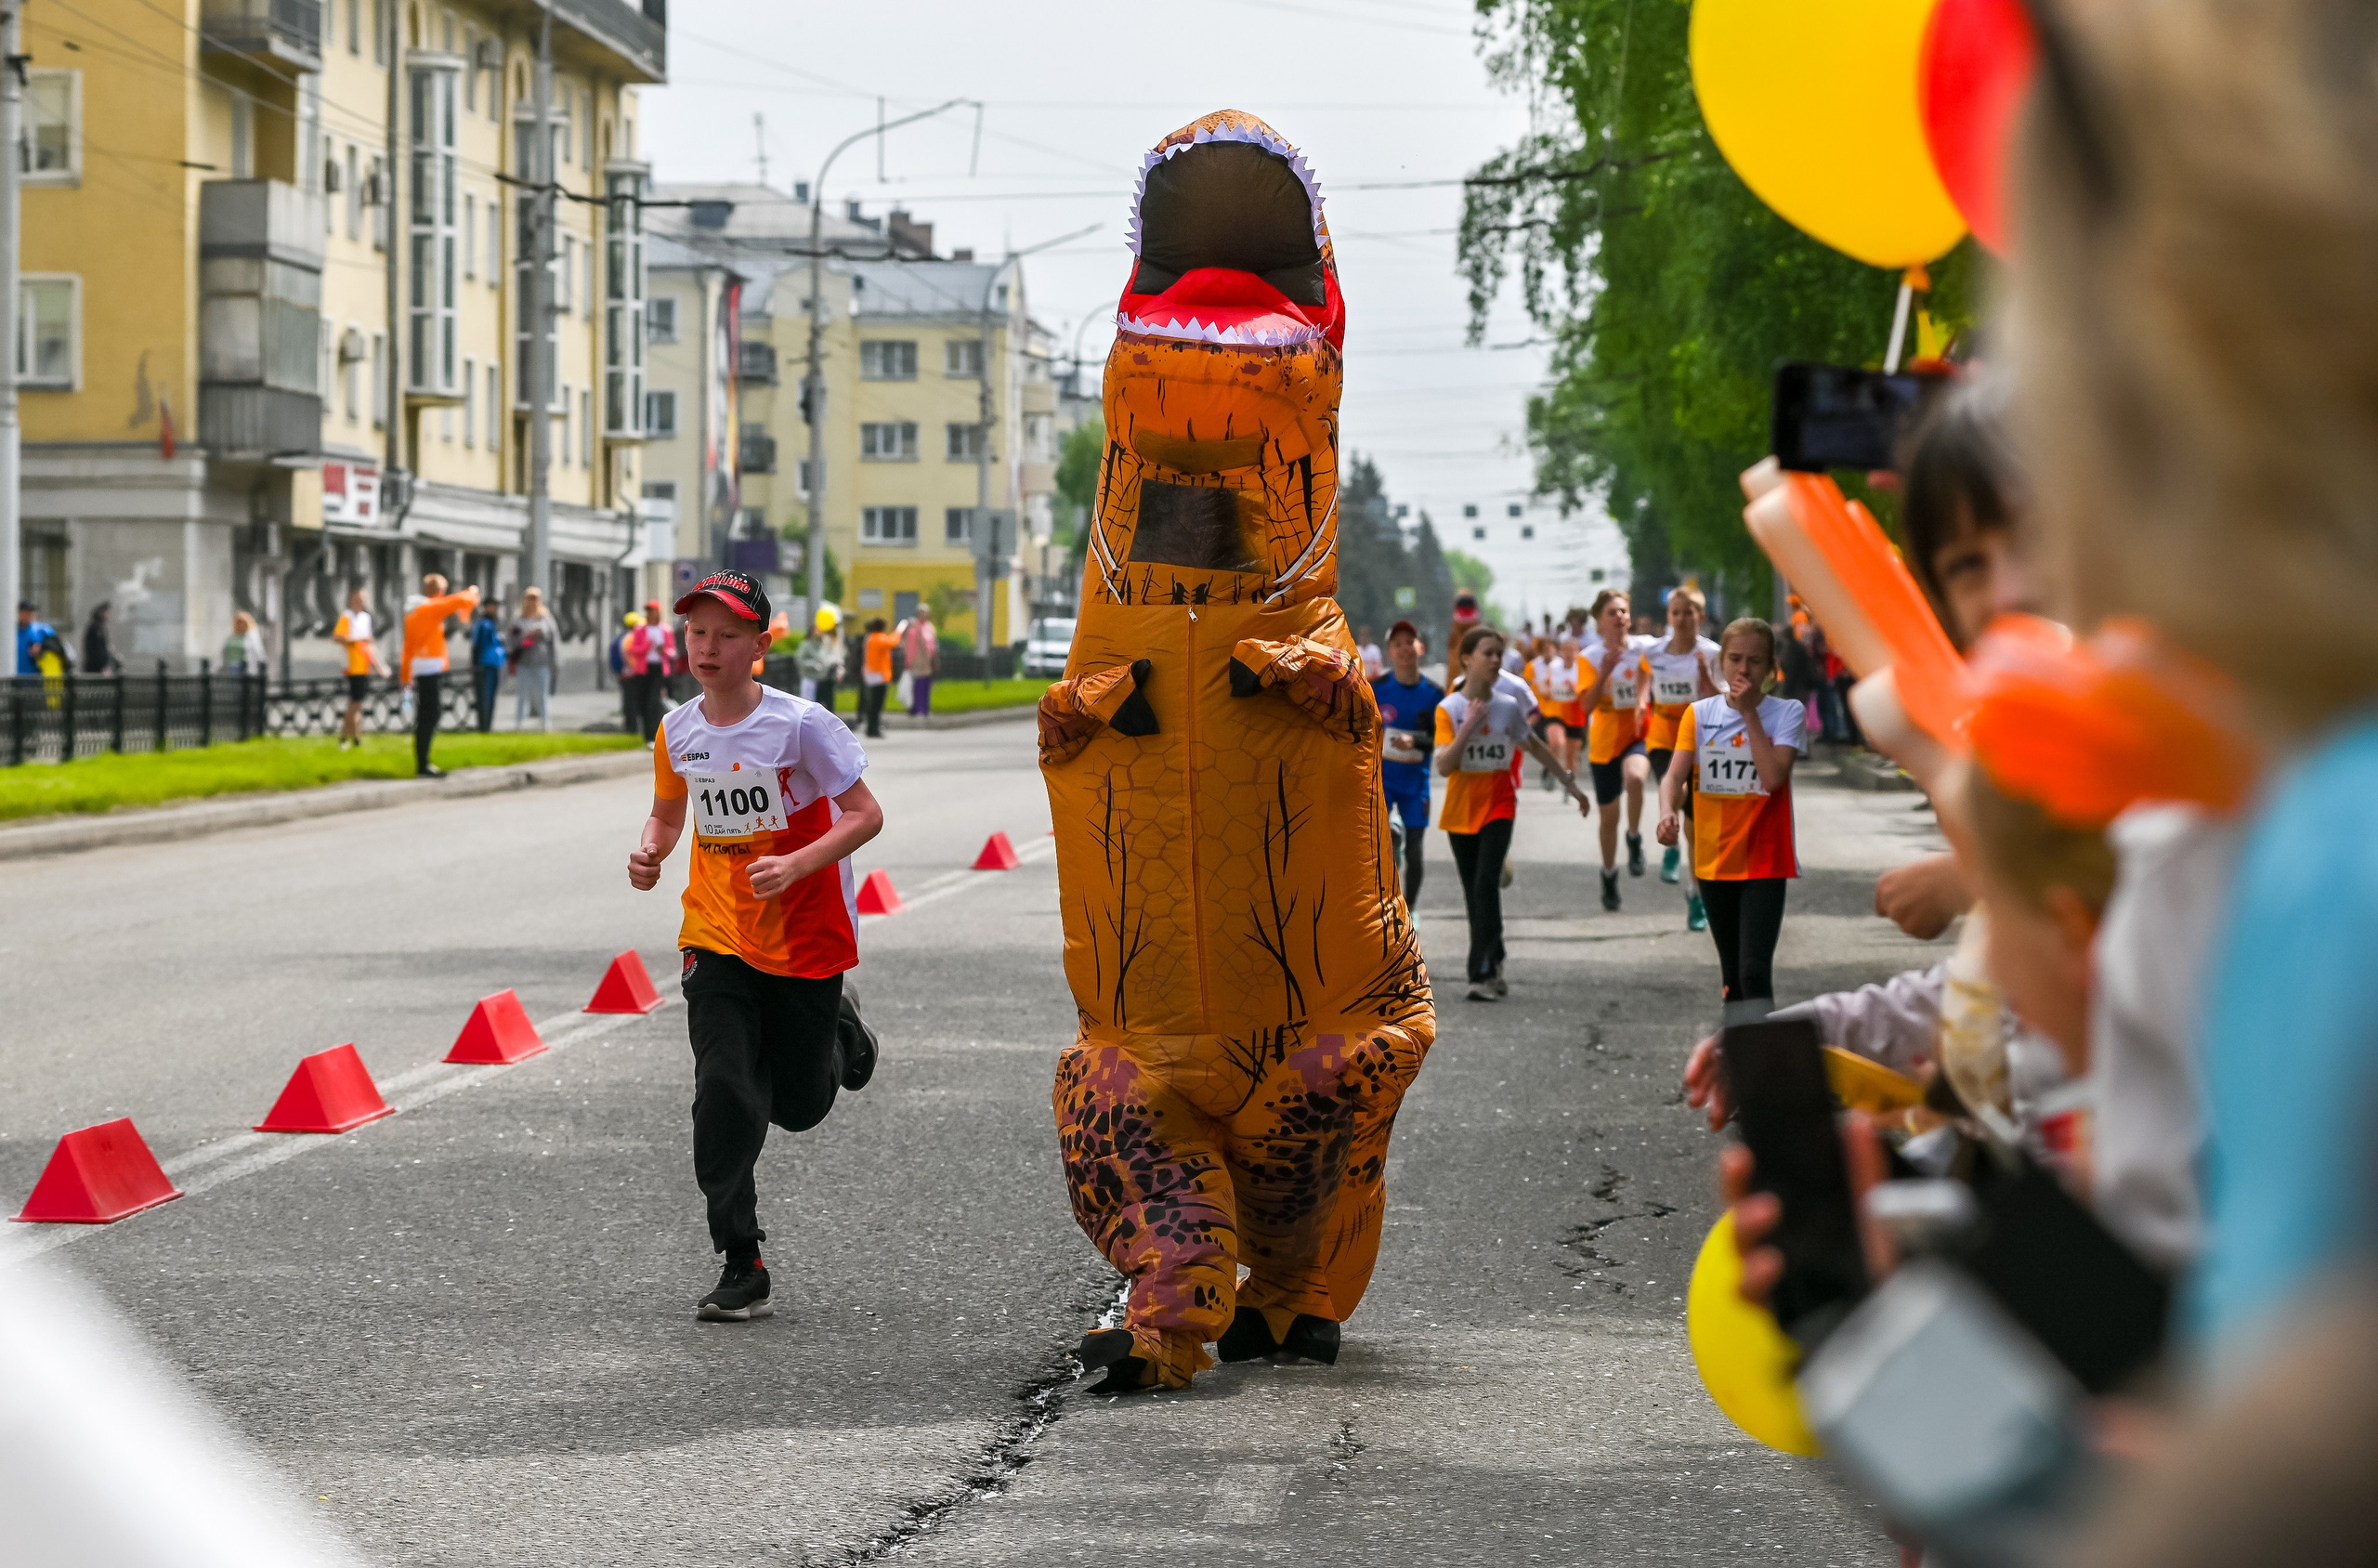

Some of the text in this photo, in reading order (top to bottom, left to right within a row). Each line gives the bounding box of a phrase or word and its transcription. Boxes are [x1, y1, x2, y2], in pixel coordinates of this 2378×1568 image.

[686, 751, 711, 761] ЕВРАЗ
[1468, 744, 1505, 760] 1143
[1708, 759, 1757, 780] 1177
[699, 786, 769, 817] 1100
[704, 824, 713, 834] 10
